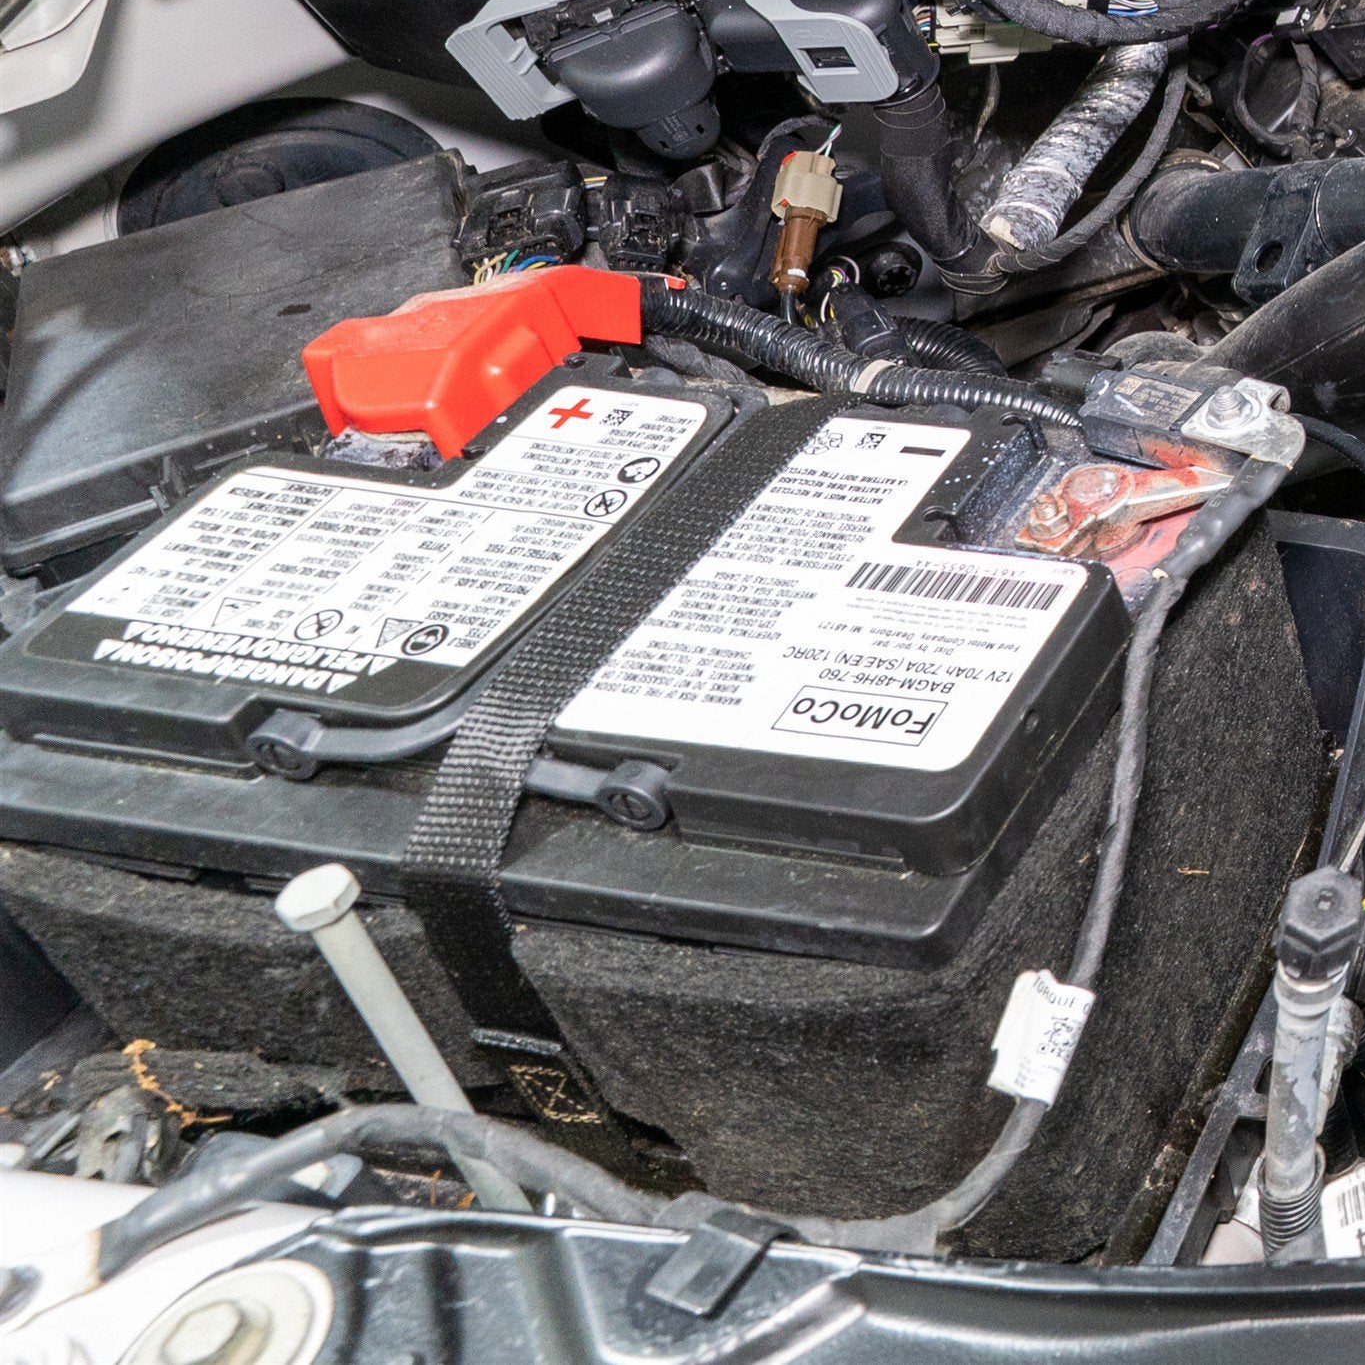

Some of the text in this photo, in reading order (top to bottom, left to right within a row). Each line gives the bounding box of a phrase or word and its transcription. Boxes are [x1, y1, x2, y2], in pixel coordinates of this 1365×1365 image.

[860, 476, 896, 485] BATTERIE
[848, 496, 883, 504] BATTERY
[967, 640, 995, 650] Motor
[997, 643, 1020, 652] Ford
[783, 646, 830, 661] 120RC
[906, 661, 942, 675] 720A
[946, 666, 983, 679] 70Ah
[819, 668, 954, 693] BAGM-48H6-760
[985, 671, 1013, 683] 12V
[793, 698, 934, 734] FoMoCo
